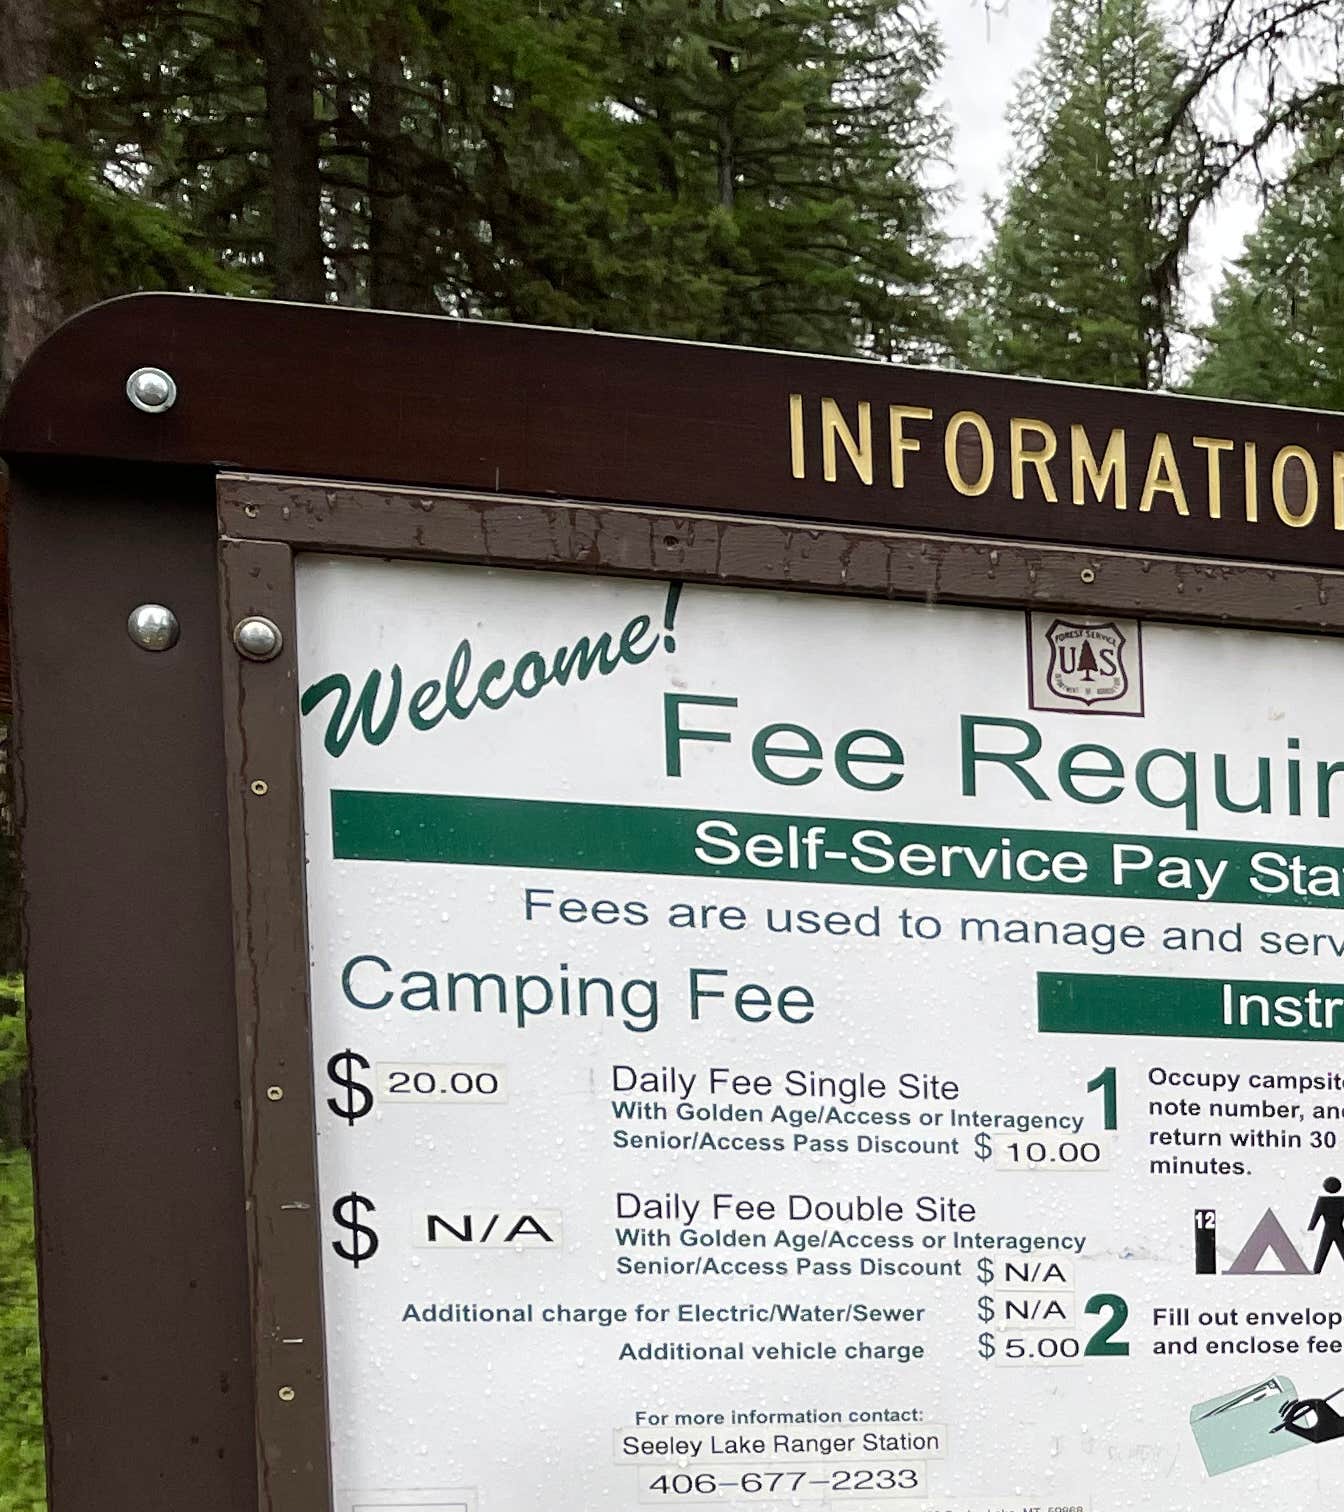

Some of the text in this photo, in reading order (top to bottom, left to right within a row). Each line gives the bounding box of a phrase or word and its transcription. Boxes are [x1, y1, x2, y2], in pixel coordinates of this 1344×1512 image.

[301, 582, 683, 758] Welcome!
[664, 693, 904, 791] Fee
[695, 821, 1087, 883] Self-Service
[1114, 844, 1228, 900] Pay
[526, 889, 648, 925] Fees
[669, 904, 746, 930] are
[767, 906, 879, 936] used
[899, 909, 941, 939] to
[962, 919, 1144, 954] manage
[1163, 923, 1241, 952] and
[342, 955, 814, 1032] Camping Fee
[327, 1049, 497, 1126] $ 20.00
[613, 1066, 958, 1104] Daily Fee Single Site
[1149, 1068, 1240, 1092] Occupy
[1150, 1099, 1200, 1115] note
[1210, 1100, 1304, 1121] number,
[1150, 1129, 1335, 1148] return within 30
[1151, 1157, 1251, 1174] minutes.
[624, 1433, 938, 1457] Seeley Lake Ranger Station
